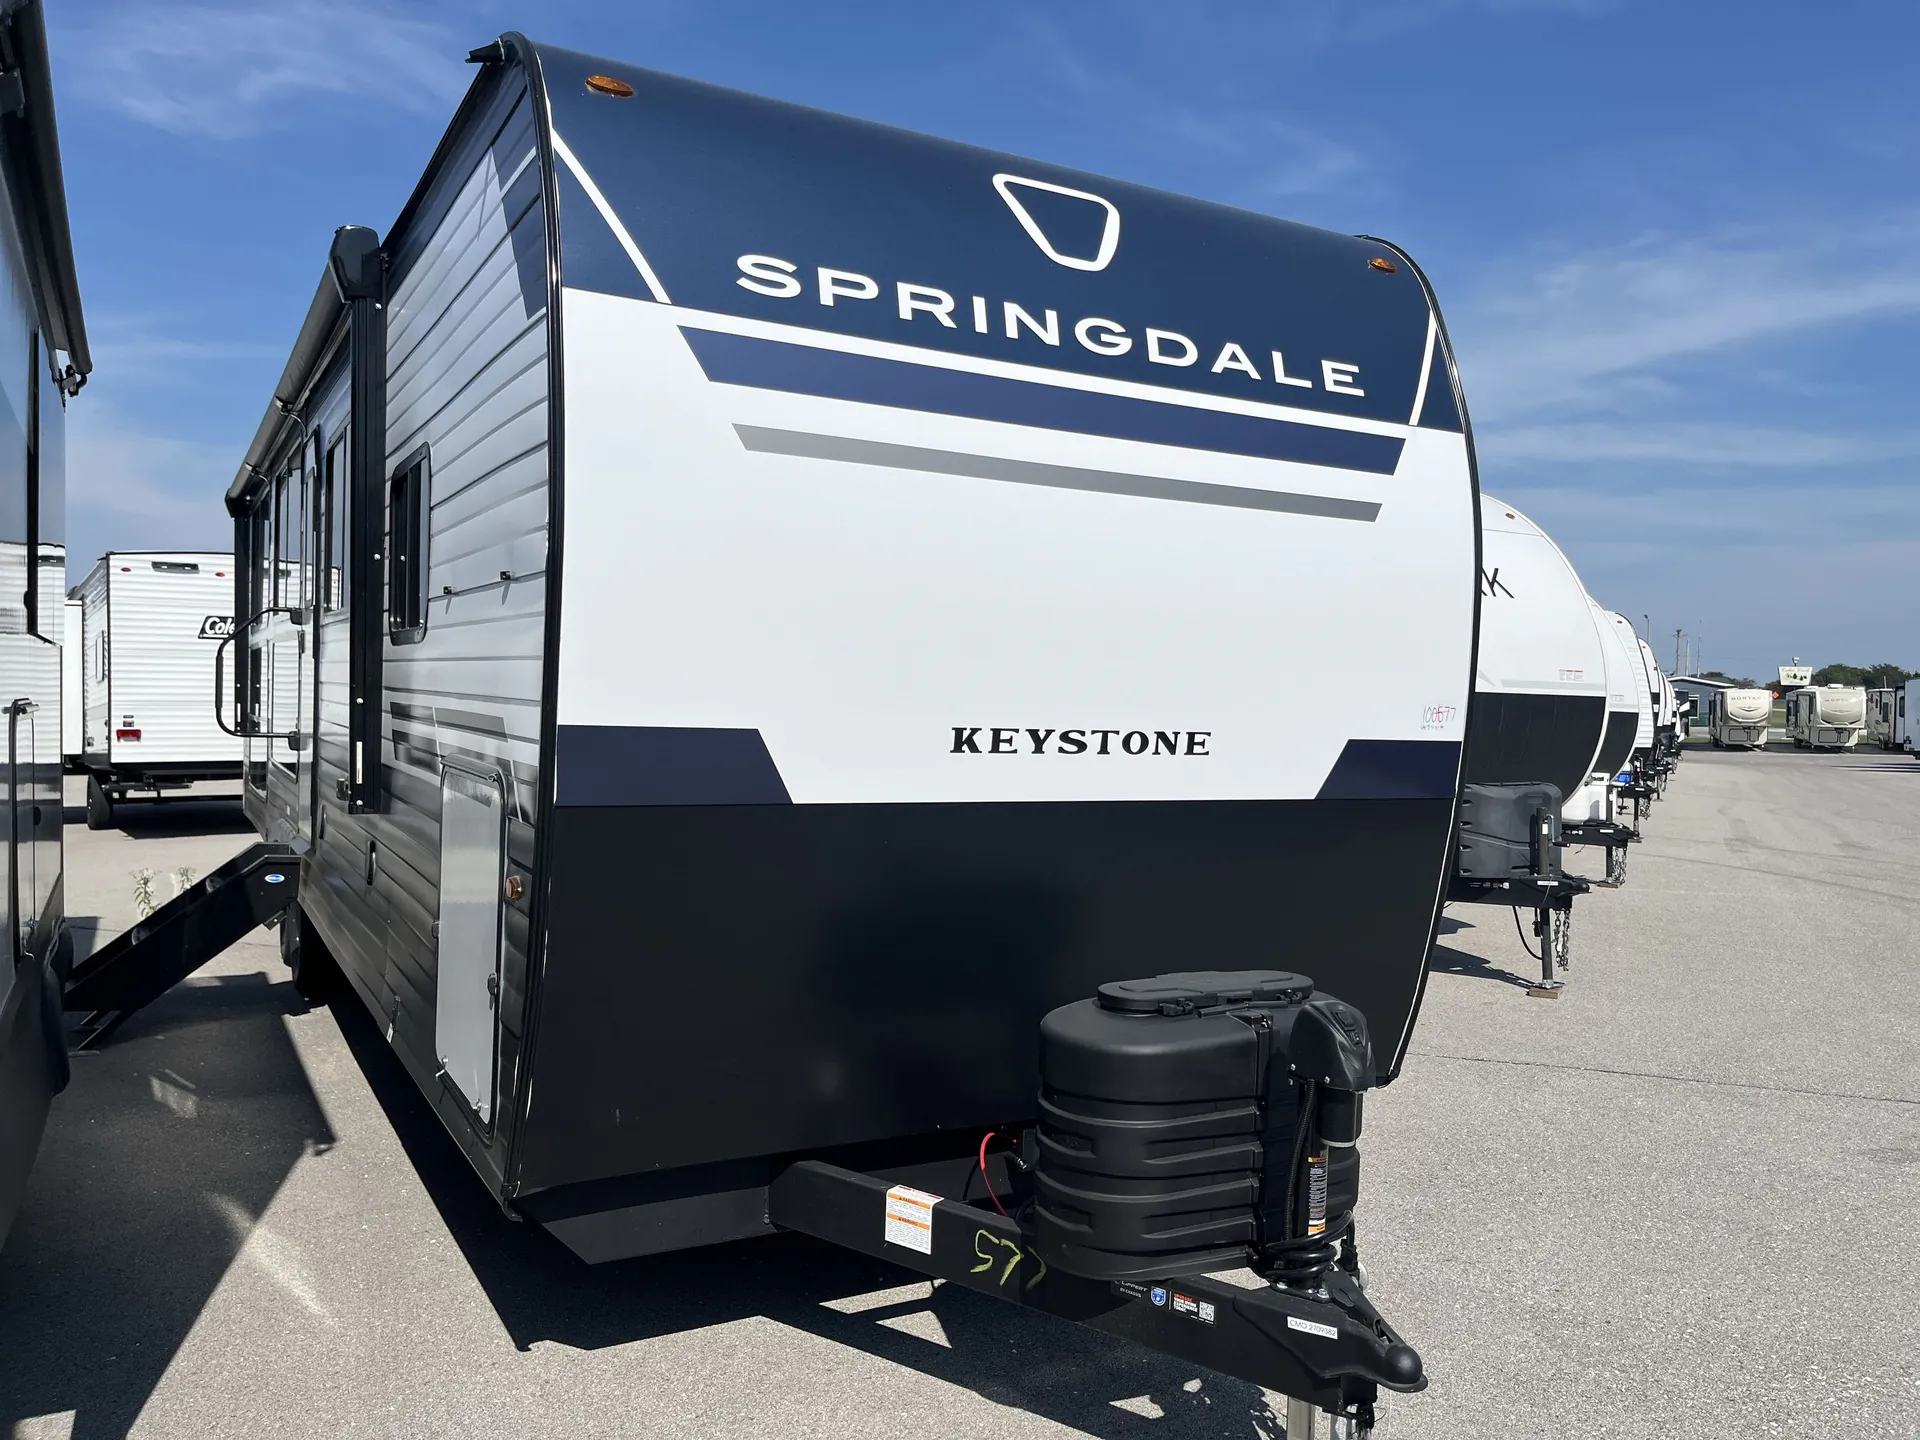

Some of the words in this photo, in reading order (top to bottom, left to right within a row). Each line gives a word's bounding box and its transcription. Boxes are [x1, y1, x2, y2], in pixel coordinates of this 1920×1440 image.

[736, 254, 1365, 397] SPRINGDALE
[950, 727, 1212, 756] KEYSTONE
[1289, 1319, 1308, 1330] CMO
[1308, 1323, 1337, 1337] 2709382
